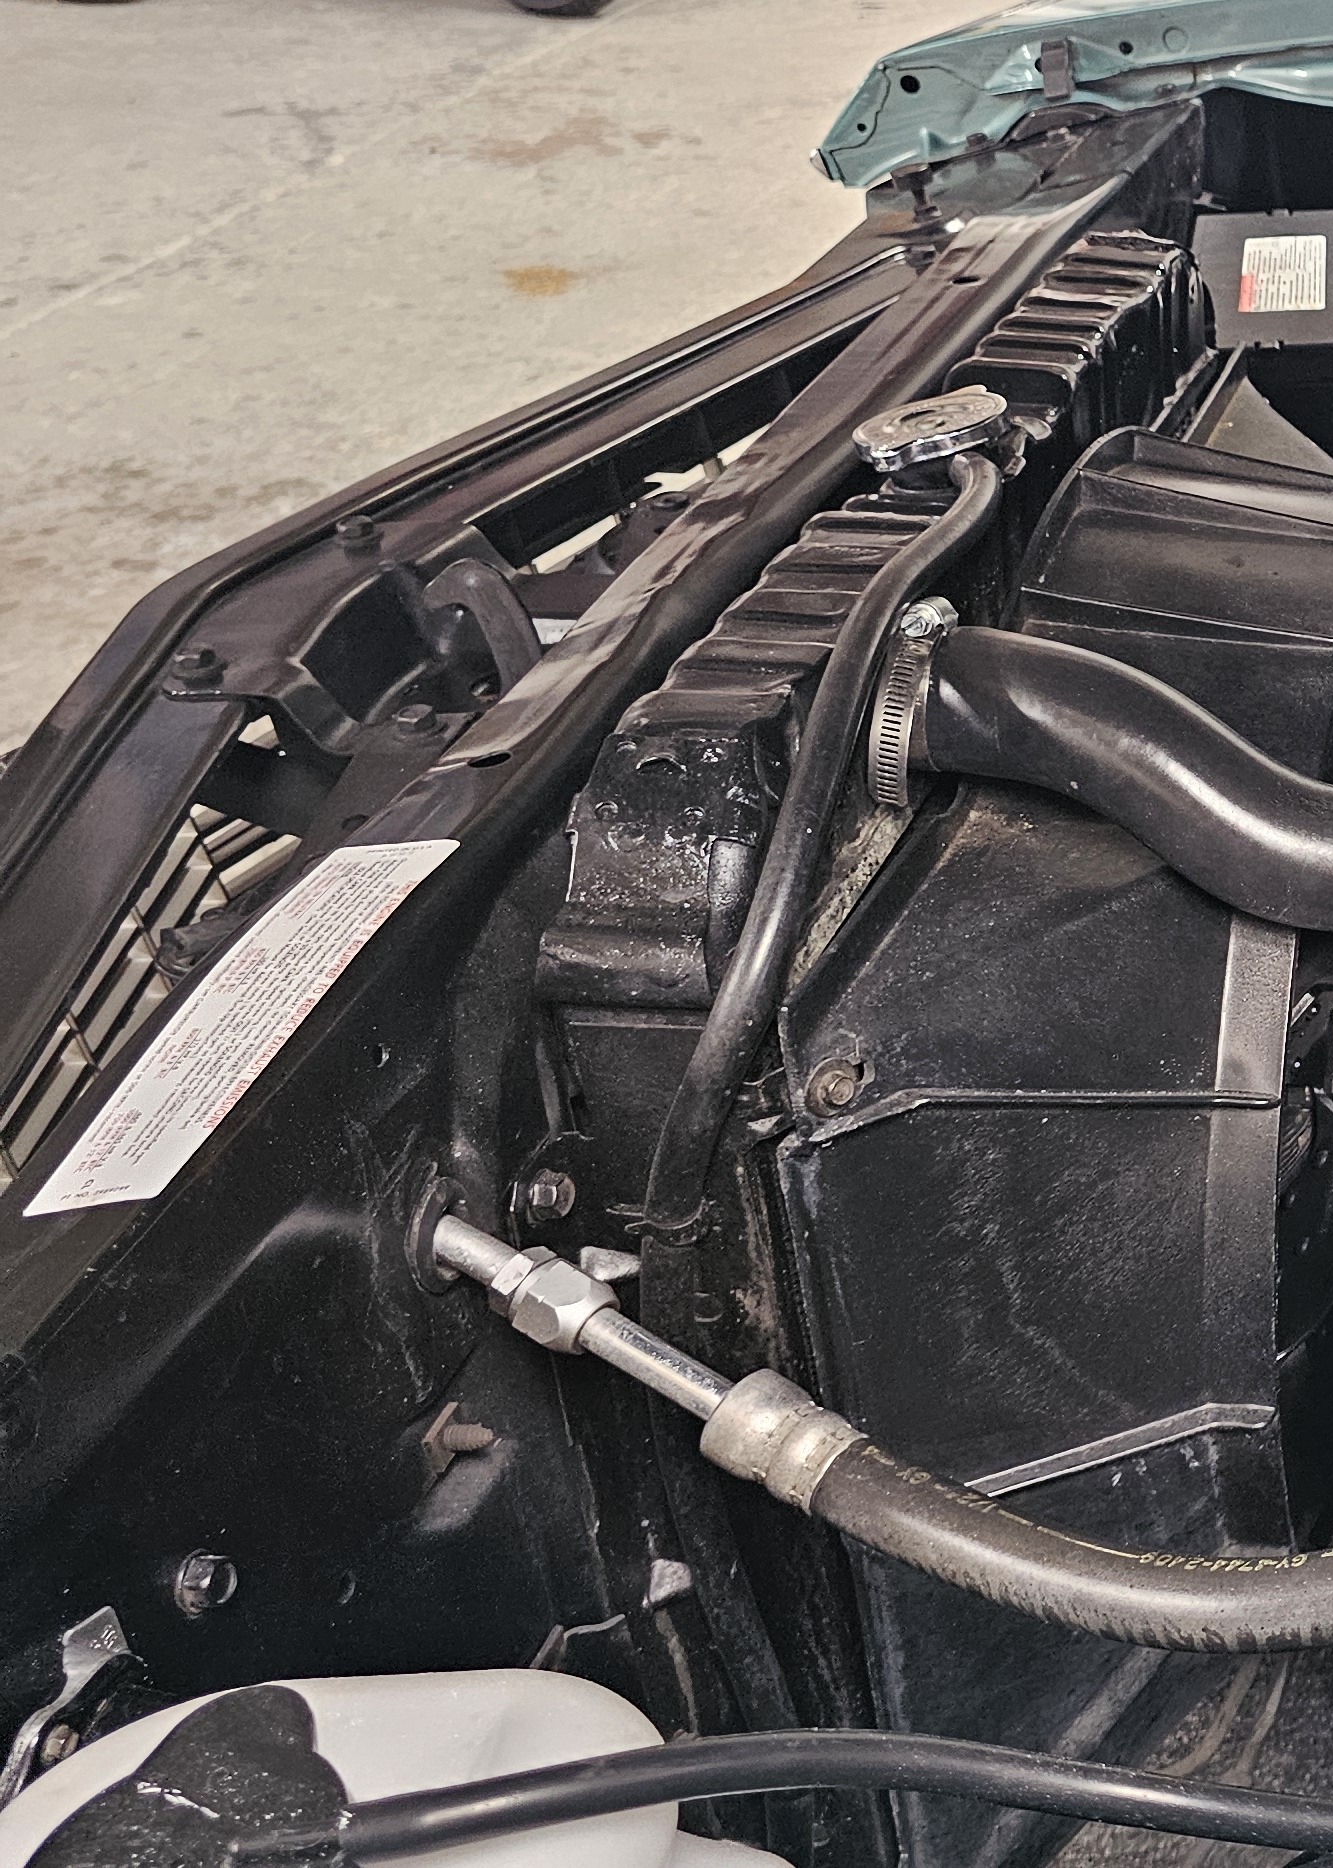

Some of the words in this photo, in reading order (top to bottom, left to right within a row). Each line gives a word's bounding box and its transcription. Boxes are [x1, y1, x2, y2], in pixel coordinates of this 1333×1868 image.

[369, 898, 400, 926] ENGINE
[325, 940, 363, 979] EQUIPPED
[313, 983, 329, 994] TO
[281, 998, 316, 1033] REDUCE
[248, 1034, 285, 1075] EXHAUST
[202, 1079, 250, 1129] EMISSIONS
